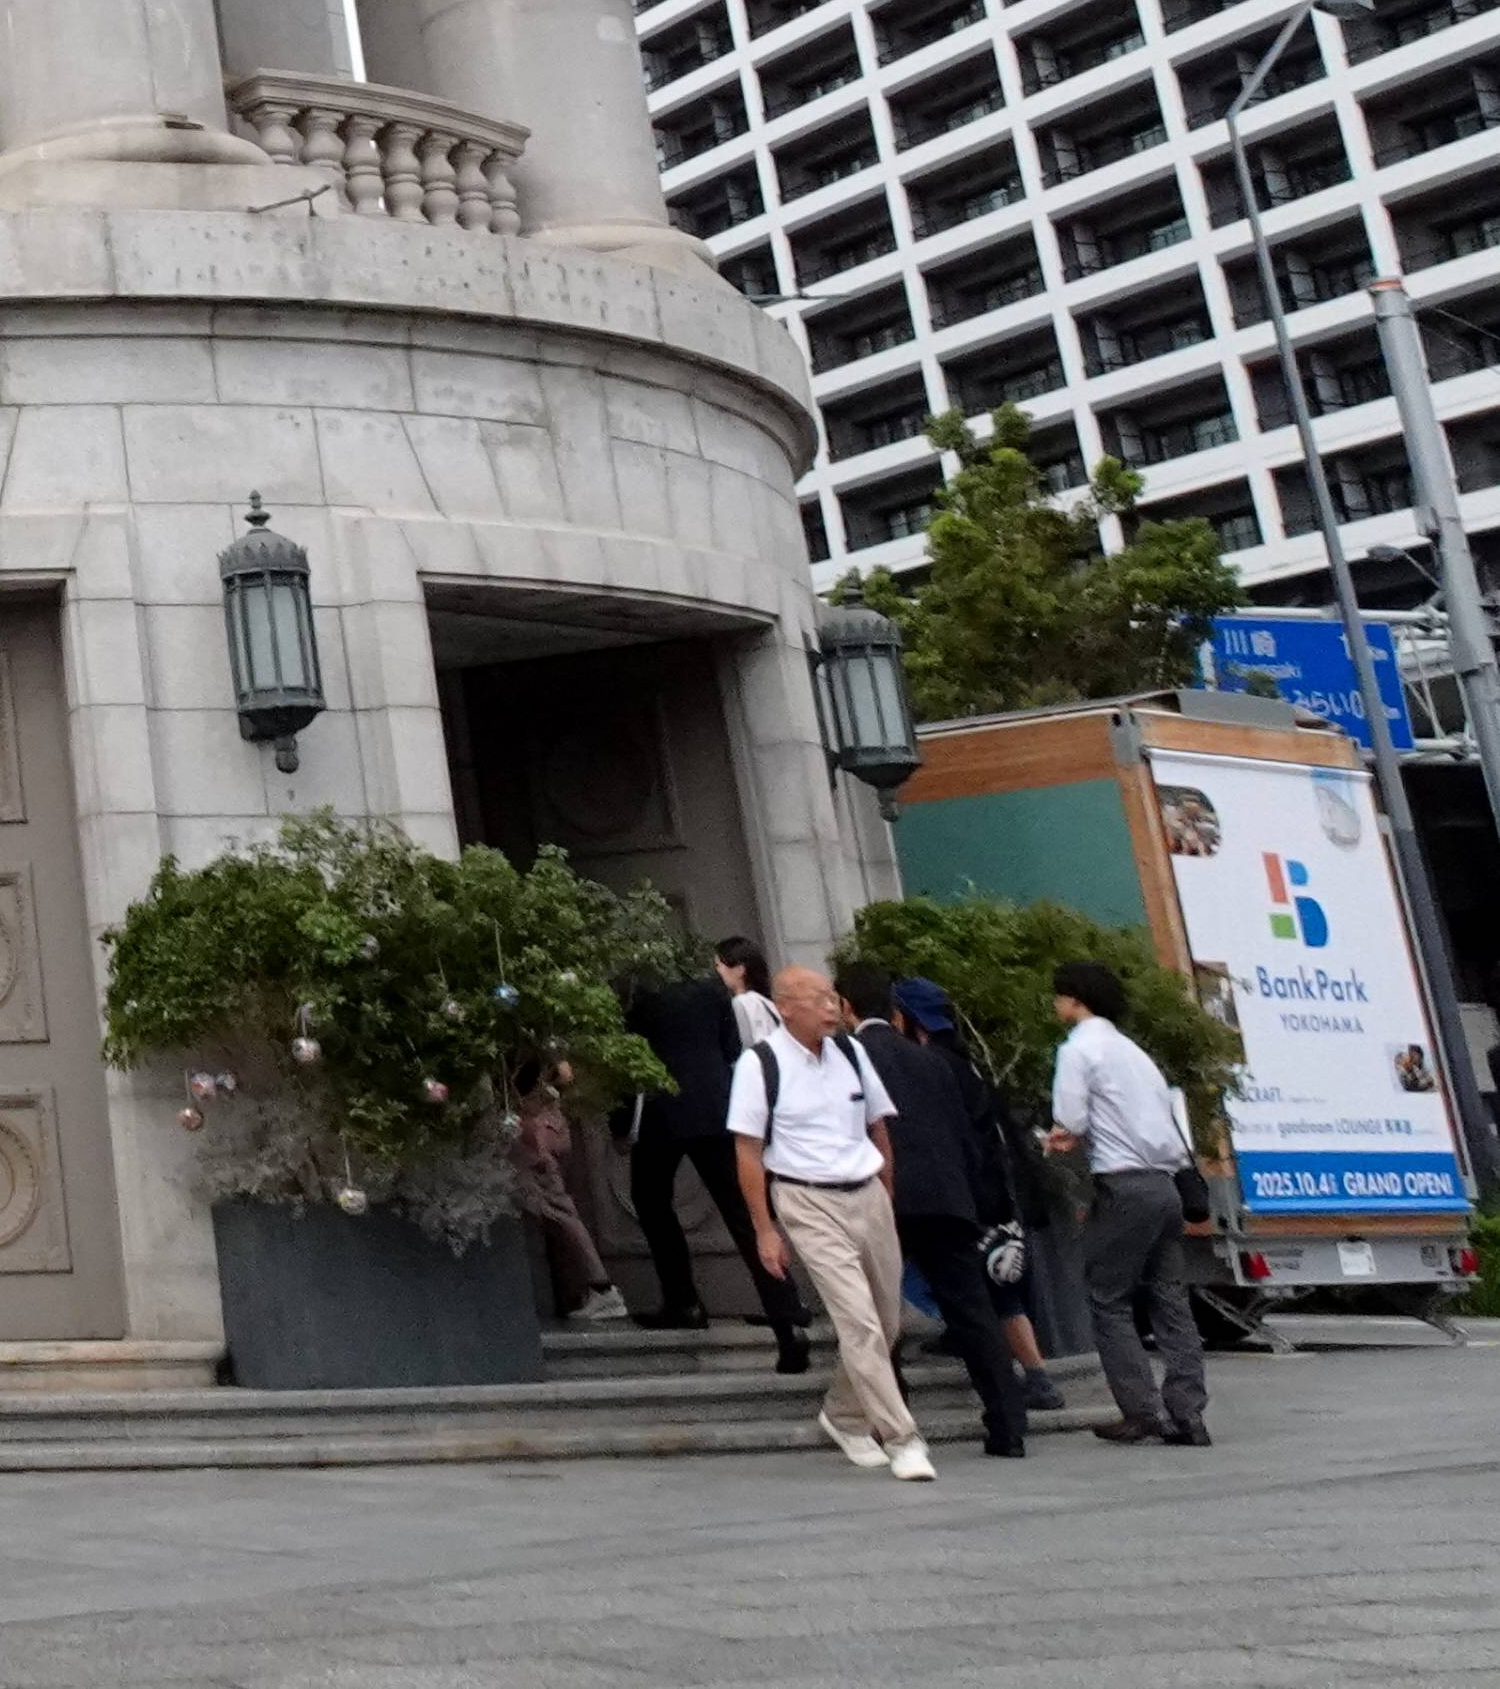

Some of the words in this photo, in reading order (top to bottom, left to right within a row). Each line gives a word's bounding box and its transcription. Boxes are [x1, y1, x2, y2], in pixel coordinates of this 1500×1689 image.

[1222, 628, 1277, 658] 川崎
[1255, 965, 1369, 1002] BankPark
[1279, 1014, 1365, 1034] YOKOHAMA
[1335, 1117, 1384, 1136] LOUNGE
[1343, 1171, 1401, 1196] GRAND
[1403, 1171, 1455, 1196] OPEN!
